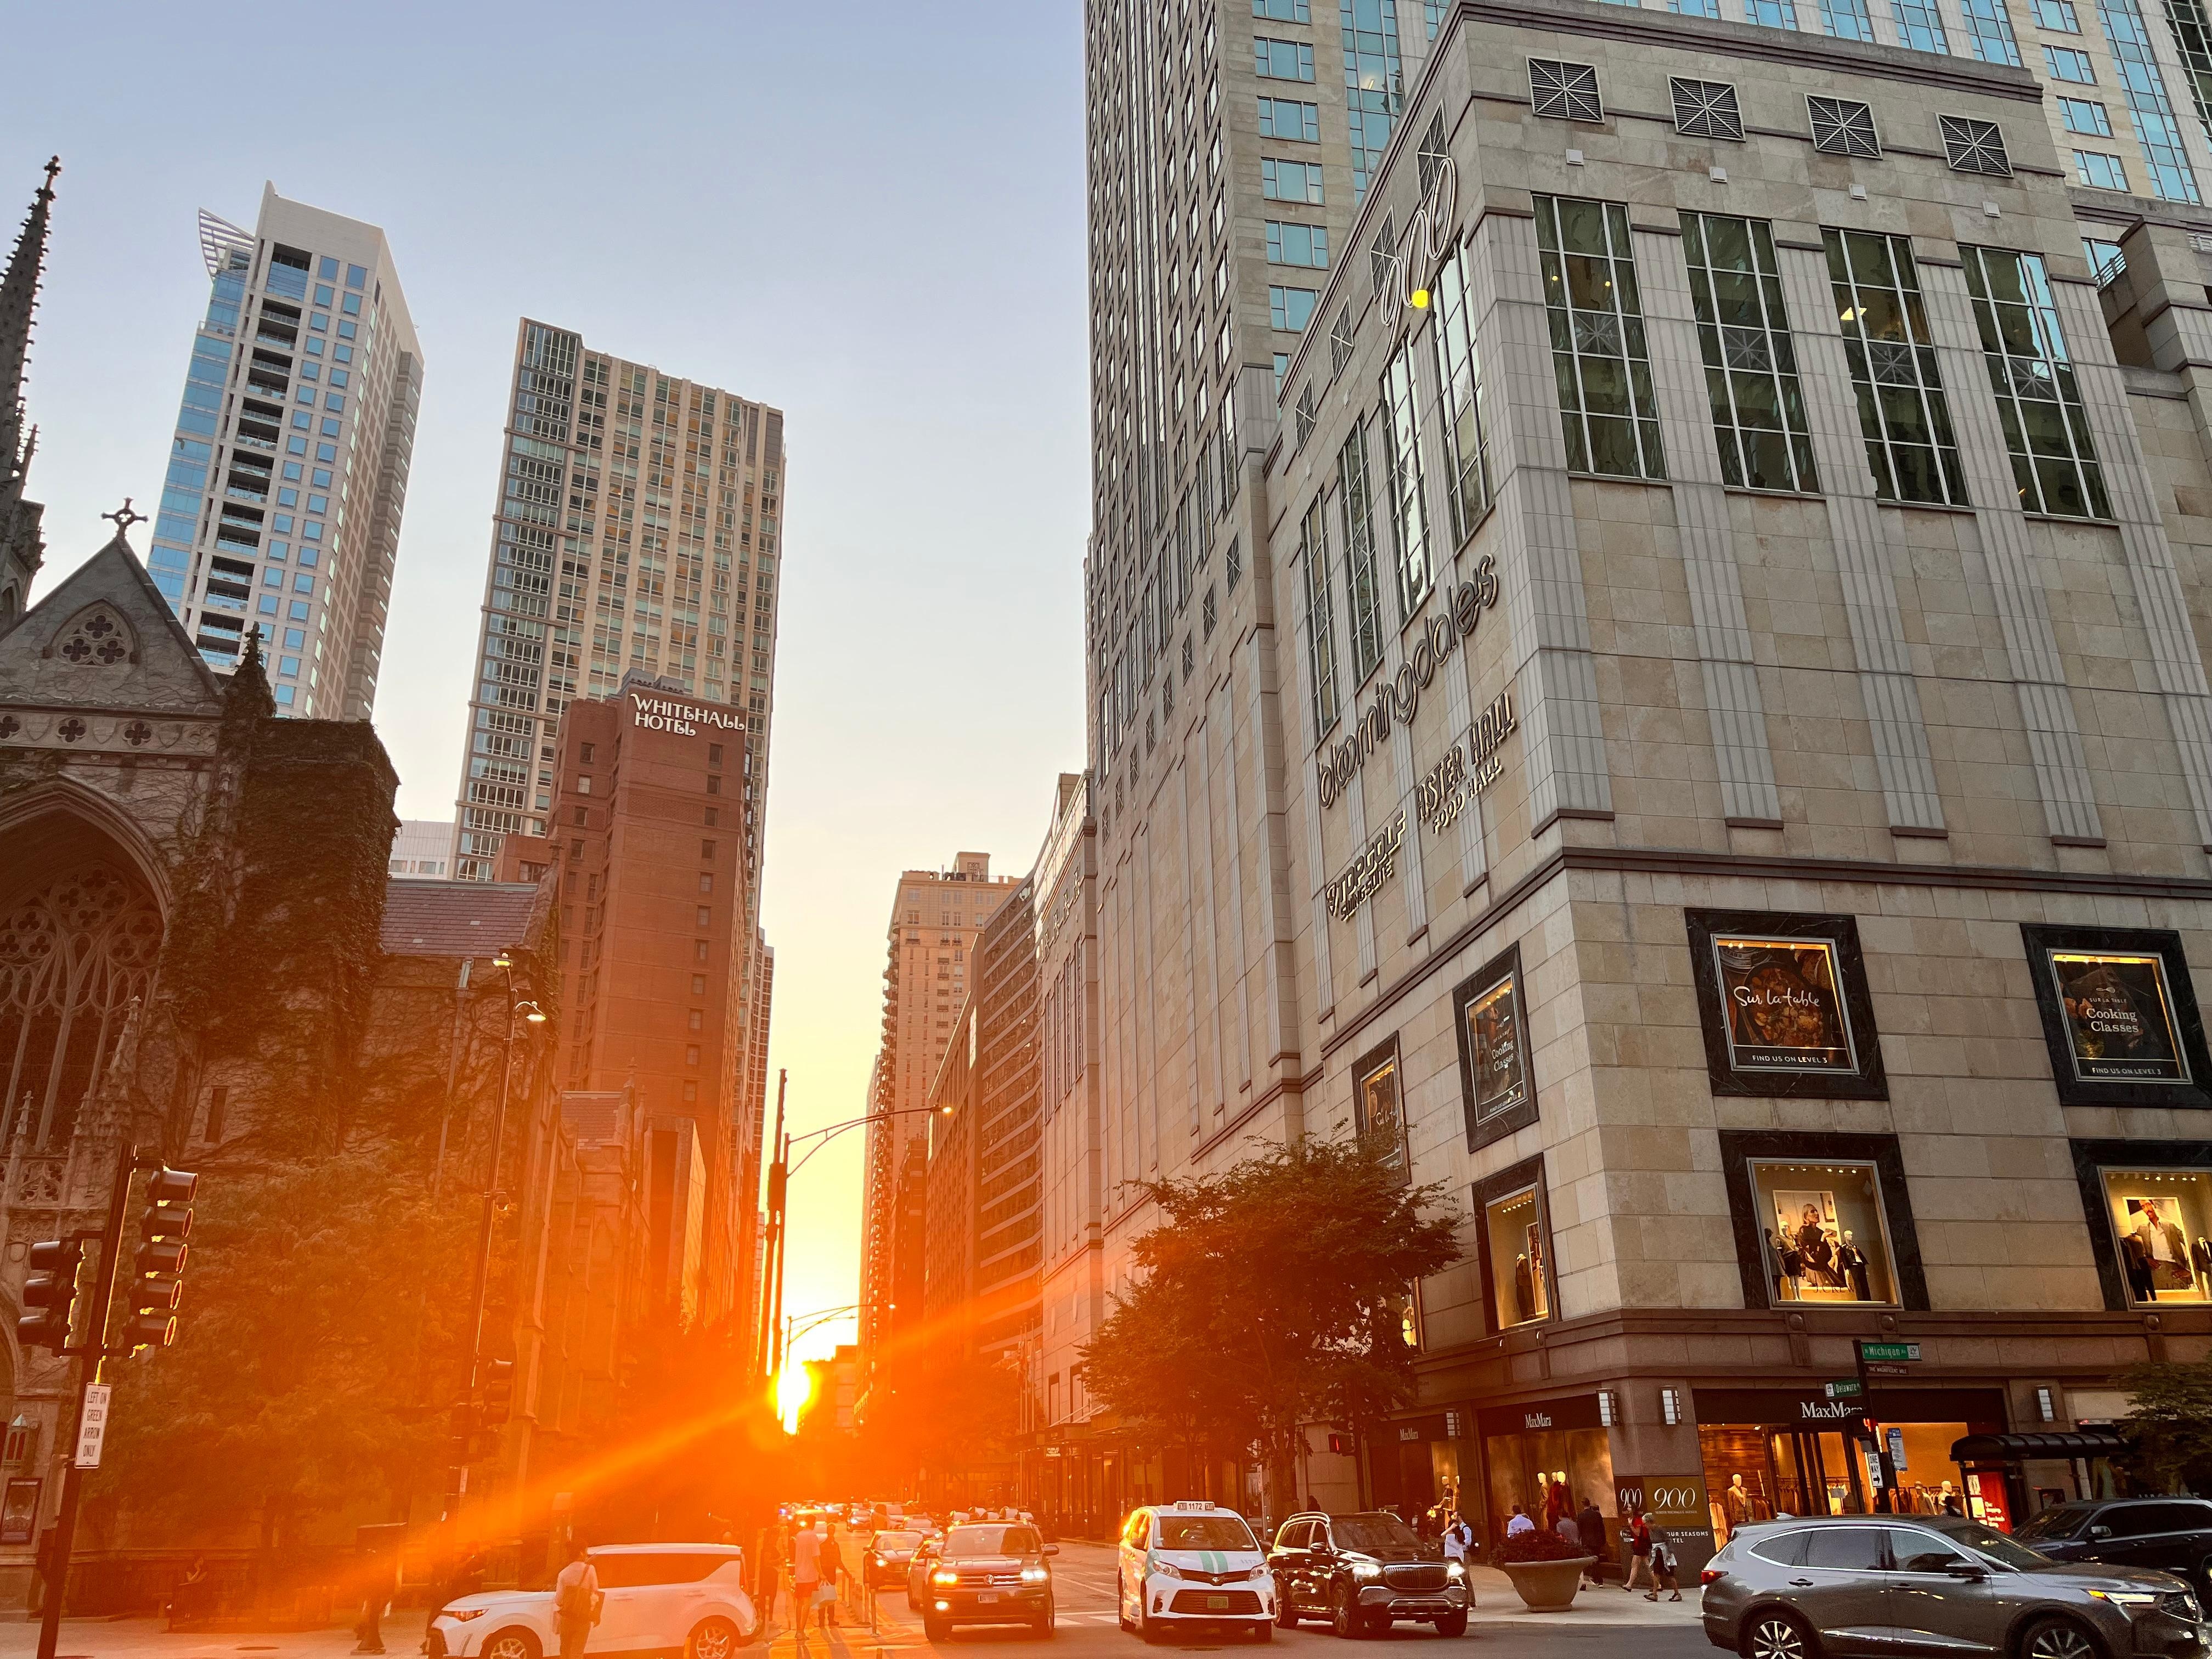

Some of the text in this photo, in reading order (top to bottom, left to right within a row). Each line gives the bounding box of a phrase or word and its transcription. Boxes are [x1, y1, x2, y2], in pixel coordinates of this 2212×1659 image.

[1380, 157, 1456, 362] 900
[630, 693, 745, 731] WHITEHALL
[635, 712, 696, 736] HOTEL
[1417, 692, 1514, 822] ASTER HALL
[1432, 756, 1502, 834] FOOD HALL
[1338, 809, 1406, 903] TOPGOLF
[1734, 986, 1820, 1007] Sur la table
[2086, 1008, 2137, 1022] Cooking
[2091, 1020, 2139, 1033] Classes
[1492, 1040, 1514, 1060] Cooking
[1493, 1053, 1514, 1071] Classes
[1869, 1346, 1900, 1359] Michigan
[1836, 1384, 1857, 1393] Delaware
[88, 1391, 107, 1404] LEFT ON
[87, 1408, 103, 1421] GREEN
[1525, 1413, 1552, 1429] MaxMara
[83, 1426, 100, 1439] ARROW
[1400, 1427, 1419, 1441] MaxMara
[83, 1444, 96, 1457] ONLY
[1654, 1487, 1696, 1510] 900
